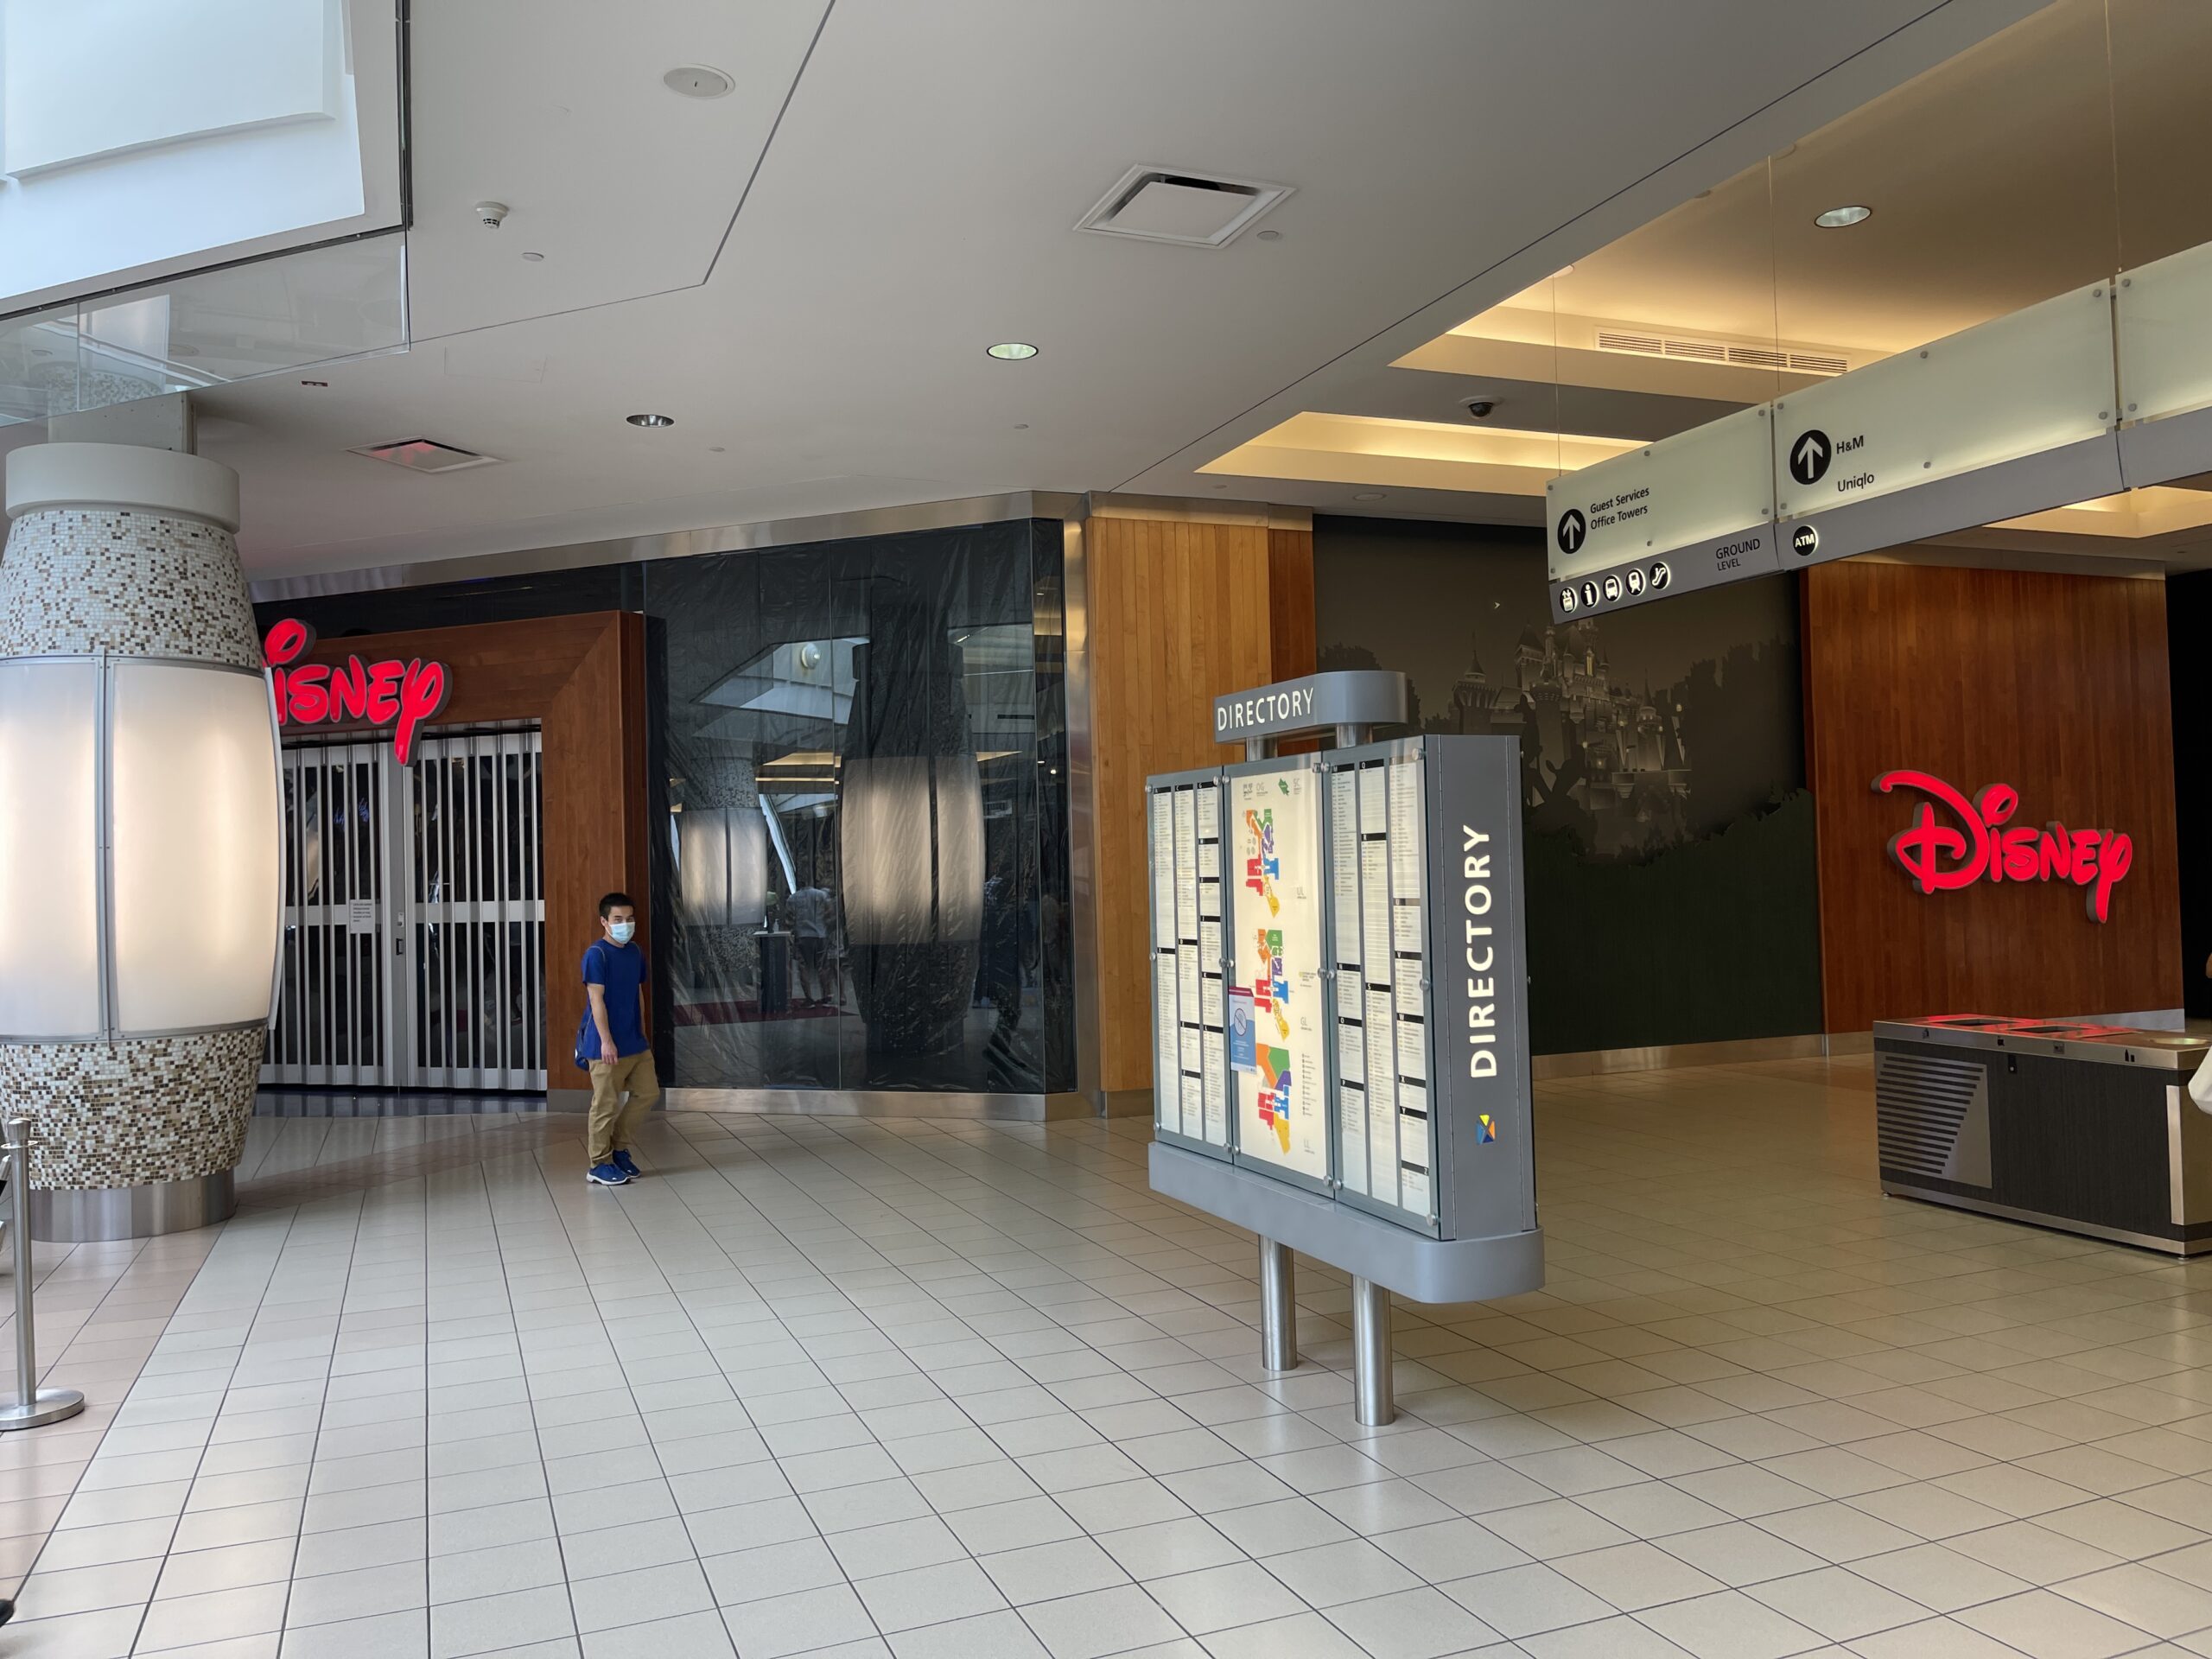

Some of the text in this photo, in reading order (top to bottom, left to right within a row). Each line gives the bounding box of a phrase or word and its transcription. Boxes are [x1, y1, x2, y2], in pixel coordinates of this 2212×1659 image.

[1836, 435, 1865, 454] H&M
[1837, 473, 1875, 493] Uniqlo
[1590, 486, 1649, 514] Guest Services
[1590, 505, 1649, 530] Office Towers
[1715, 538, 1761, 560] GROUND
[1794, 533, 1815, 548] ATM
[1717, 557, 1742, 571] LEVEL
[262, 618, 444, 766] isney
[1217, 687, 1314, 731] DIRECTORY
[1875, 769, 2133, 924] Disney
[1463, 824, 1497, 1078] DIRECTORY
